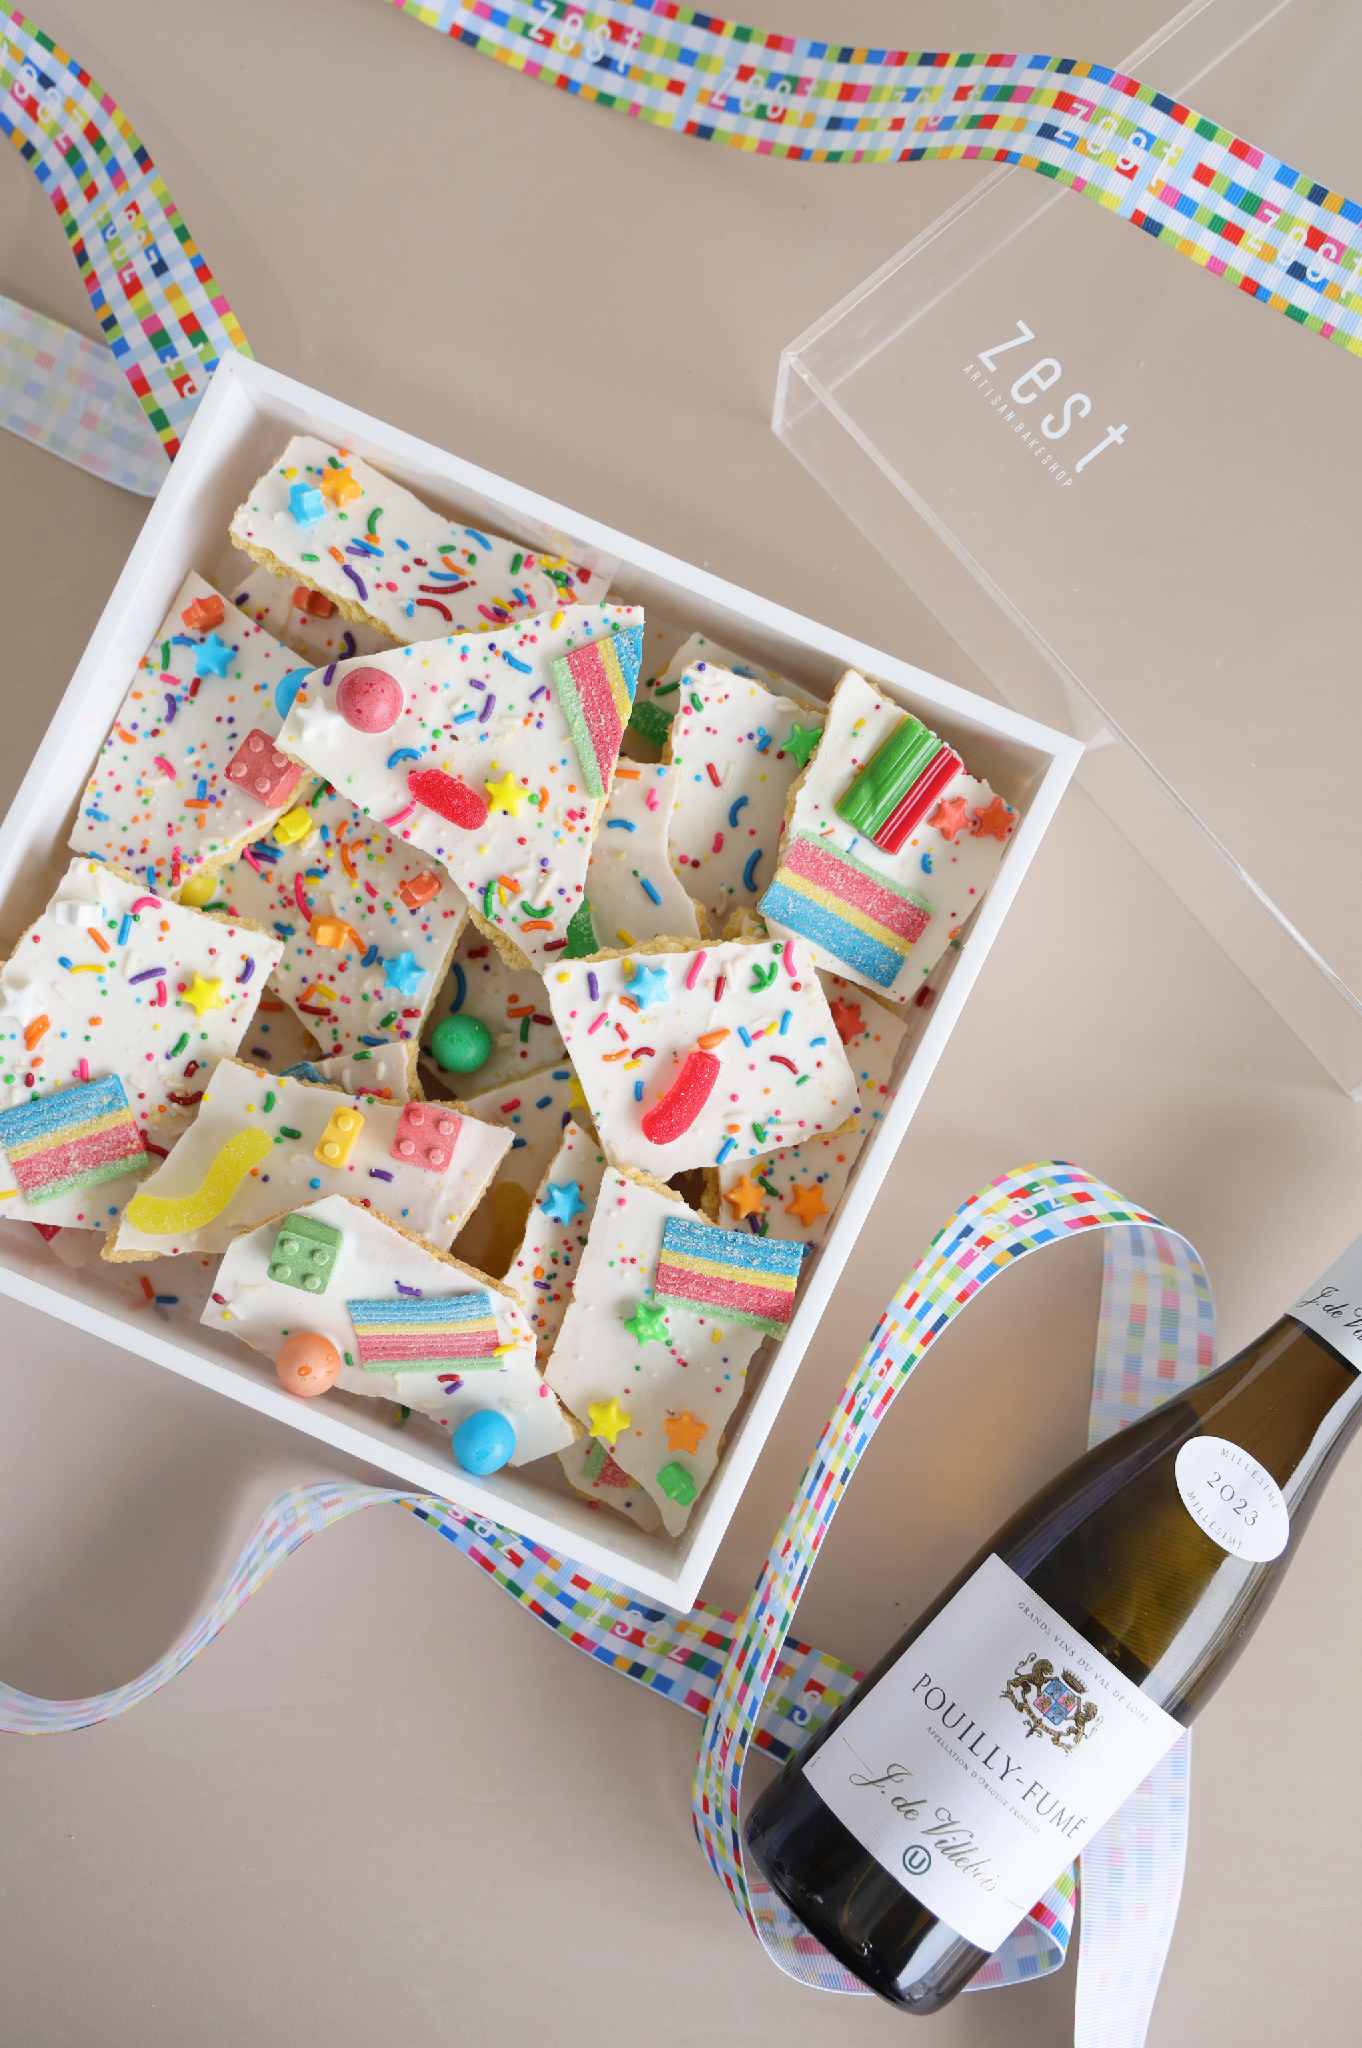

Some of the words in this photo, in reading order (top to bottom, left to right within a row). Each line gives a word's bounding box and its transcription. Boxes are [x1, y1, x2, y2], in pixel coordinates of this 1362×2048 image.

[529, 1, 641, 74] zest
[711, 68, 818, 123] zest
[879, 85, 981, 128] zest
[1055, 103, 1183, 187] zest
[978, 319, 1129, 474] zest
[959, 1184, 1067, 1257] zest
[1295, 1286, 1339, 1309] J.
[1322, 1303, 1349, 1319] de
[1206, 1471, 1258, 1526] 2023
[586, 1597, 707, 1663] zest
[1018, 1601, 1051, 1635] GRANDS
[1054, 1634, 1076, 1657] VINS
[1077, 1657, 1093, 1672] DU
[1094, 1673, 1110, 1690] VAL
[1112, 1689, 1126, 1703] DE
[1126, 1702, 1149, 1724] LOIRE
[911, 1672, 1089, 1838] POUILLY-FUMÉ
[925, 1726, 970, 1771] APPELLATION
[849, 1763, 913, 1795] J.
[891, 1796, 928, 1821] de
[920, 1807, 1000, 1892] Villebois
